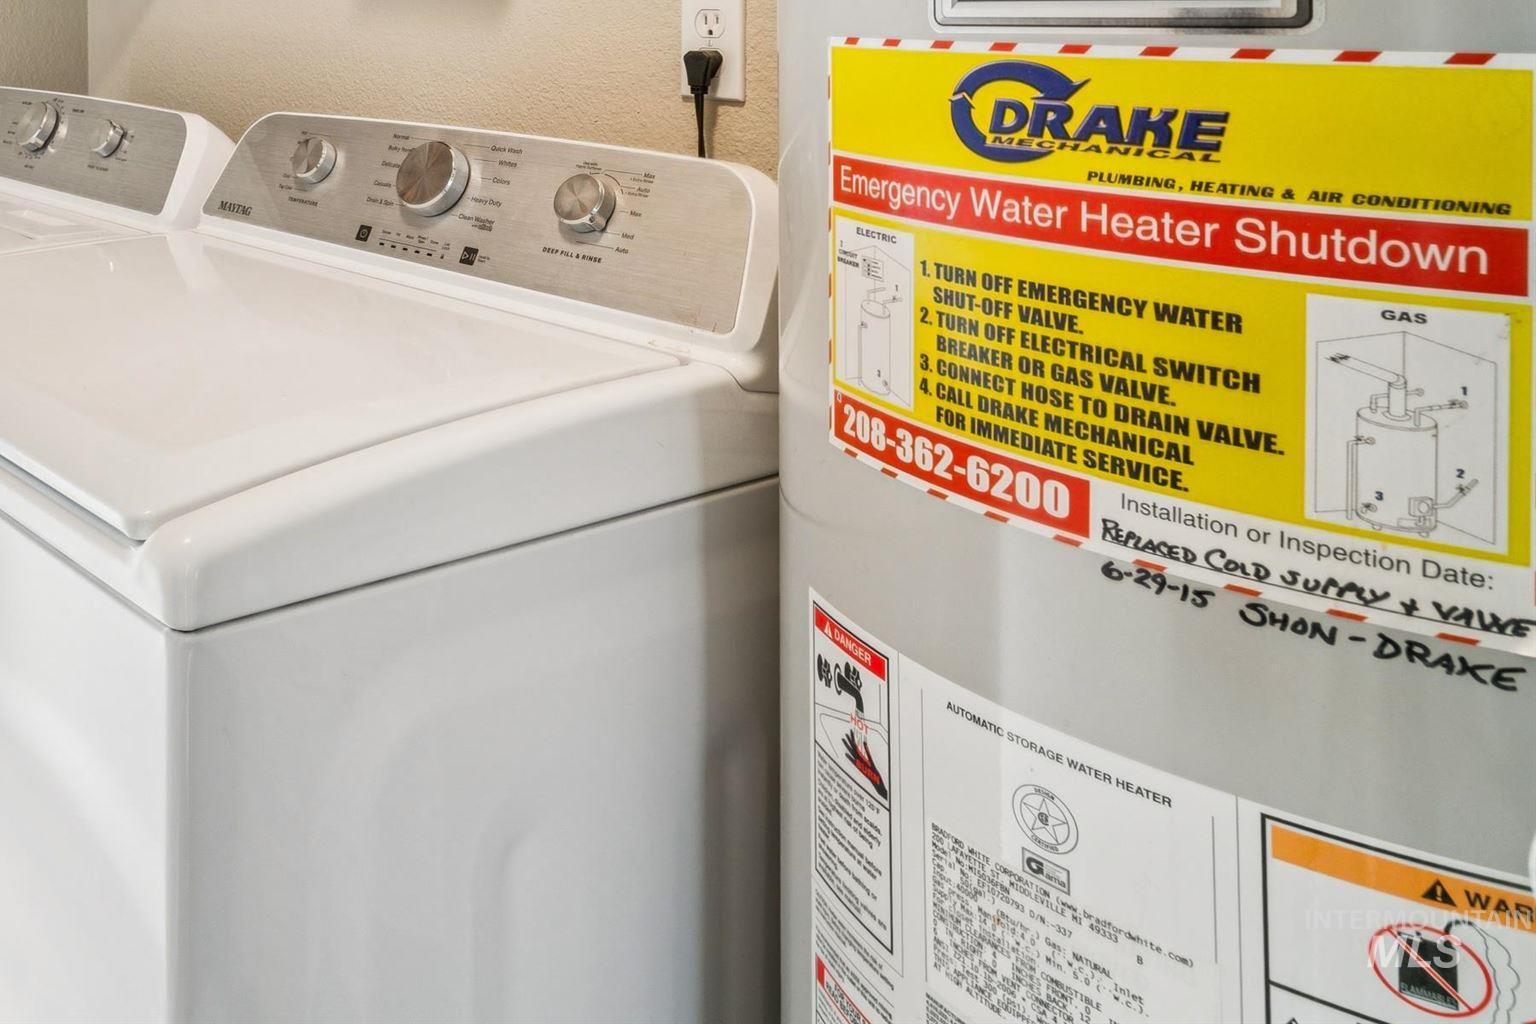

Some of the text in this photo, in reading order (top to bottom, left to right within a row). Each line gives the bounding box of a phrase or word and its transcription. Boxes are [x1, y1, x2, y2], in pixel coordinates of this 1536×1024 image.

[989, 97, 1230, 152] DRAKE
[498, 160, 517, 168] Whites
[991, 136, 1222, 163] MECHANICAL
[492, 177, 510, 185] Colors
[1189, 179, 1274, 199] HEATING
[1281, 188, 1295, 200] &
[1307, 190, 1343, 204] AIR
[1352, 193, 1512, 216] CONDITIONING
[218, 199, 252, 216] MAYTAG
[288, 196, 318, 207] TEMPERATURE
[471, 196, 502, 208] Heavy Duty
[839, 164, 1489, 275] Emergency Water Heater Shutdown
[474, 216, 495, 225] Washer
[856, 226, 897, 244] ELECTRIC
[542, 246, 559, 255] DEEP
[560, 250, 573, 258] FILL
[581, 255, 602, 263] RINSE
[919, 260, 1243, 334] 1. TURN OFF EMERGENCY WATER
[933, 287, 1084, 335] SHUT-OFF VALVE.
[1380, 309, 1428, 324] GAS
[919, 306, 1261, 394] 2. TURN OFF ELECTRICAL SWITCH
[936, 335, 1176, 407] BREAKER OR GAS VALVE.
[919, 353, 1285, 456] 3. CONNECT HOSE TO DRAIN VALVE.
[1461, 386, 1468, 396] 1
[919, 377, 1195, 465] 4. CALL DRAKE MECHANICAL
[842, 403, 1070, 519] 208-362-6200
[936, 406, 1190, 493] FOR IMMEDIATE SERVICE.
[1456, 469, 1465, 479] 2
[1375, 491, 1384, 501] 3
[1120, 492, 1494, 591] Installation or Inspection Date:
[1101, 559, 1216, 609] 6-29-15
[834, 628, 872, 667] DANGER
[1372, 632, 1527, 693] DRAKE
[850, 712, 869, 735] HOT
[946, 700, 1172, 808] AUTOMATIC STORAGE WATER HEATER
[931, 823, 964, 850] BRADFORD
[967, 845, 990, 866] WHITE
[994, 861, 1050, 899] CORPORATION
[1031, 835, 1059, 852] CERTIFIED
[1008, 878, 1066, 918] MIDDLEVILLE
[1071, 912, 1082, 926] MI
[1089, 921, 1118, 944] 49333
[1072, 949, 1113, 980] NATURAL
[1025, 988, 1073, 1024] CONNECTOR
[1040, 969, 1102, 1013] COMBUSTIBLE
[1114, 981, 1143, 1006] Inlet
